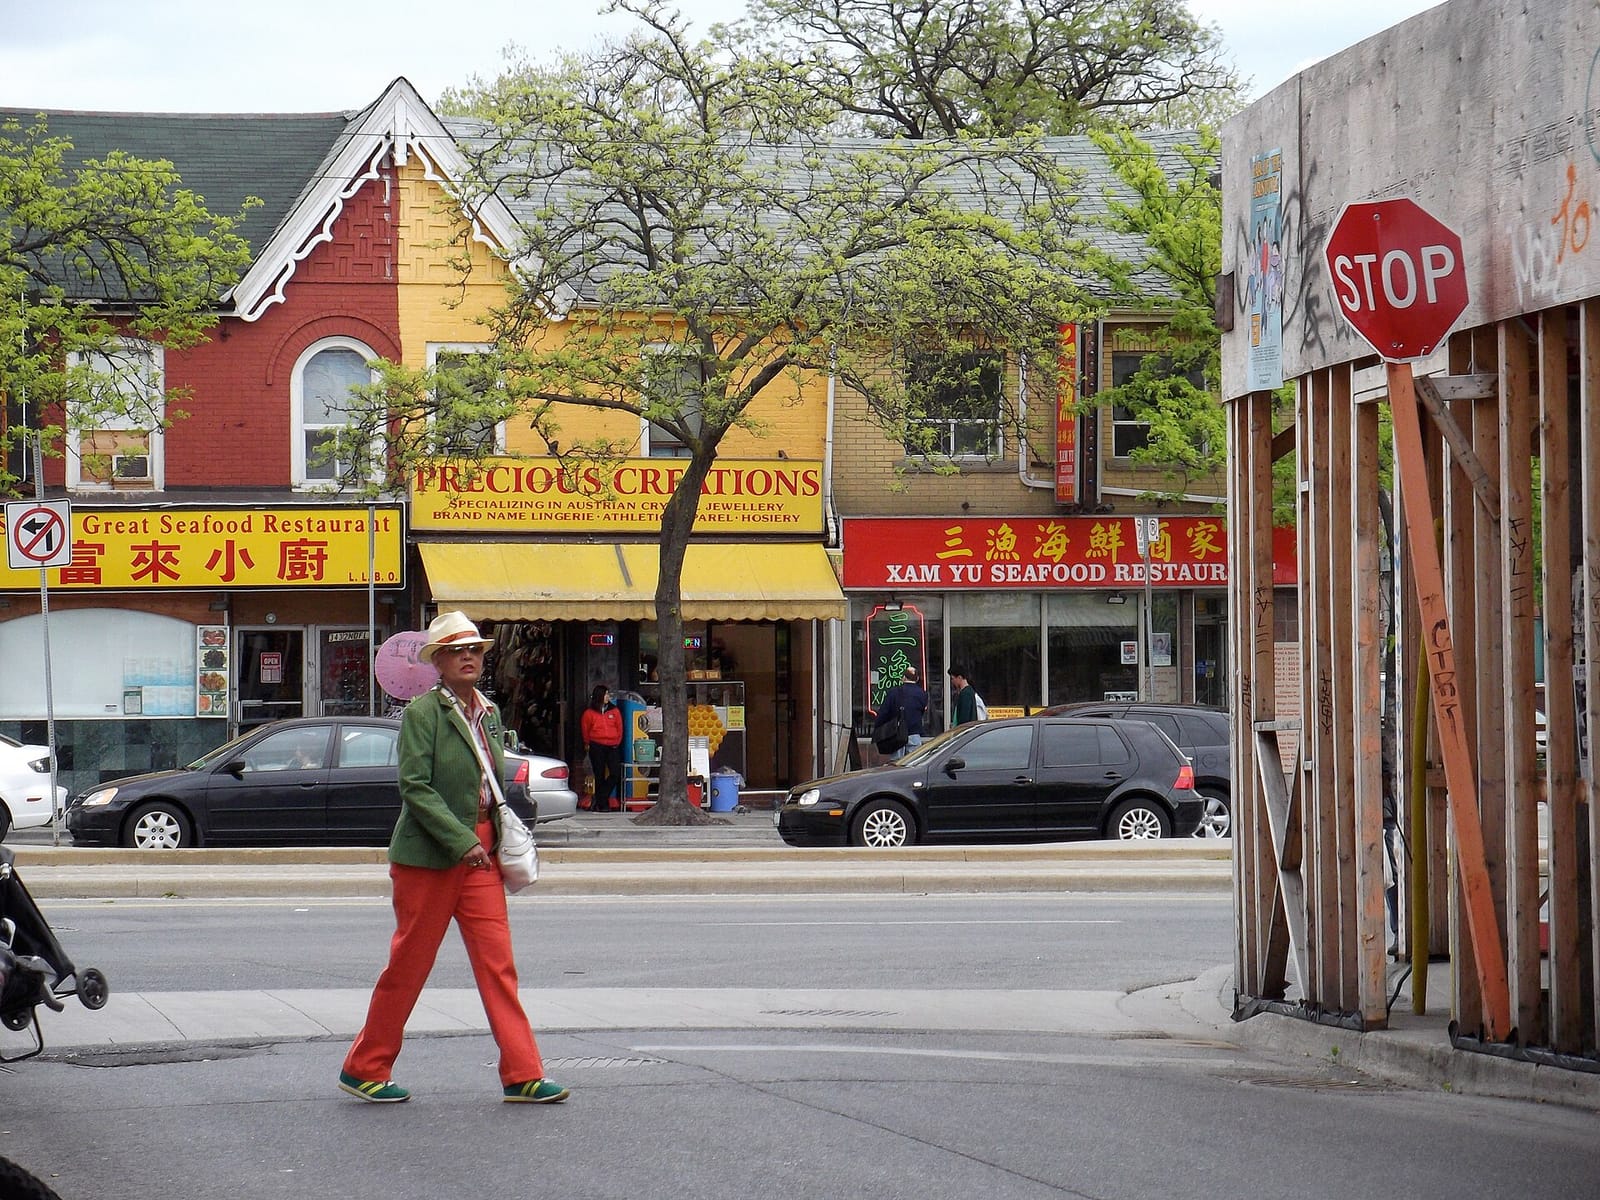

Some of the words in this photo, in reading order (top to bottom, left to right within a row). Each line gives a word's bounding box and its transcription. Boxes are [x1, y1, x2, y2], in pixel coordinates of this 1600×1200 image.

[1335, 245, 1455, 312] STOP
[415, 466, 602, 494] PRECIOUS
[449, 500, 545, 510] SPECIALIZING
[548, 501, 562, 510] IN
[567, 501, 636, 511] AUSTRIAN
[705, 503, 785, 512] JEWELLERY
[82, 515, 149, 535] Great
[160, 514, 253, 535] Seafood
[263, 514, 390, 533] Restaurant
[432, 511, 482, 520] BRAND
[487, 512, 526, 521] NAME
[531, 512, 593, 521] LINGERIE
[741, 514, 801, 523] HOSIERY
[886, 564, 942, 583] XAM
[948, 564, 983, 583] YU
[991, 564, 1106, 583] SEAFOOD
[1113, 563, 1276, 582] RESTAUR
[264, 657, 279, 666] OPEN
